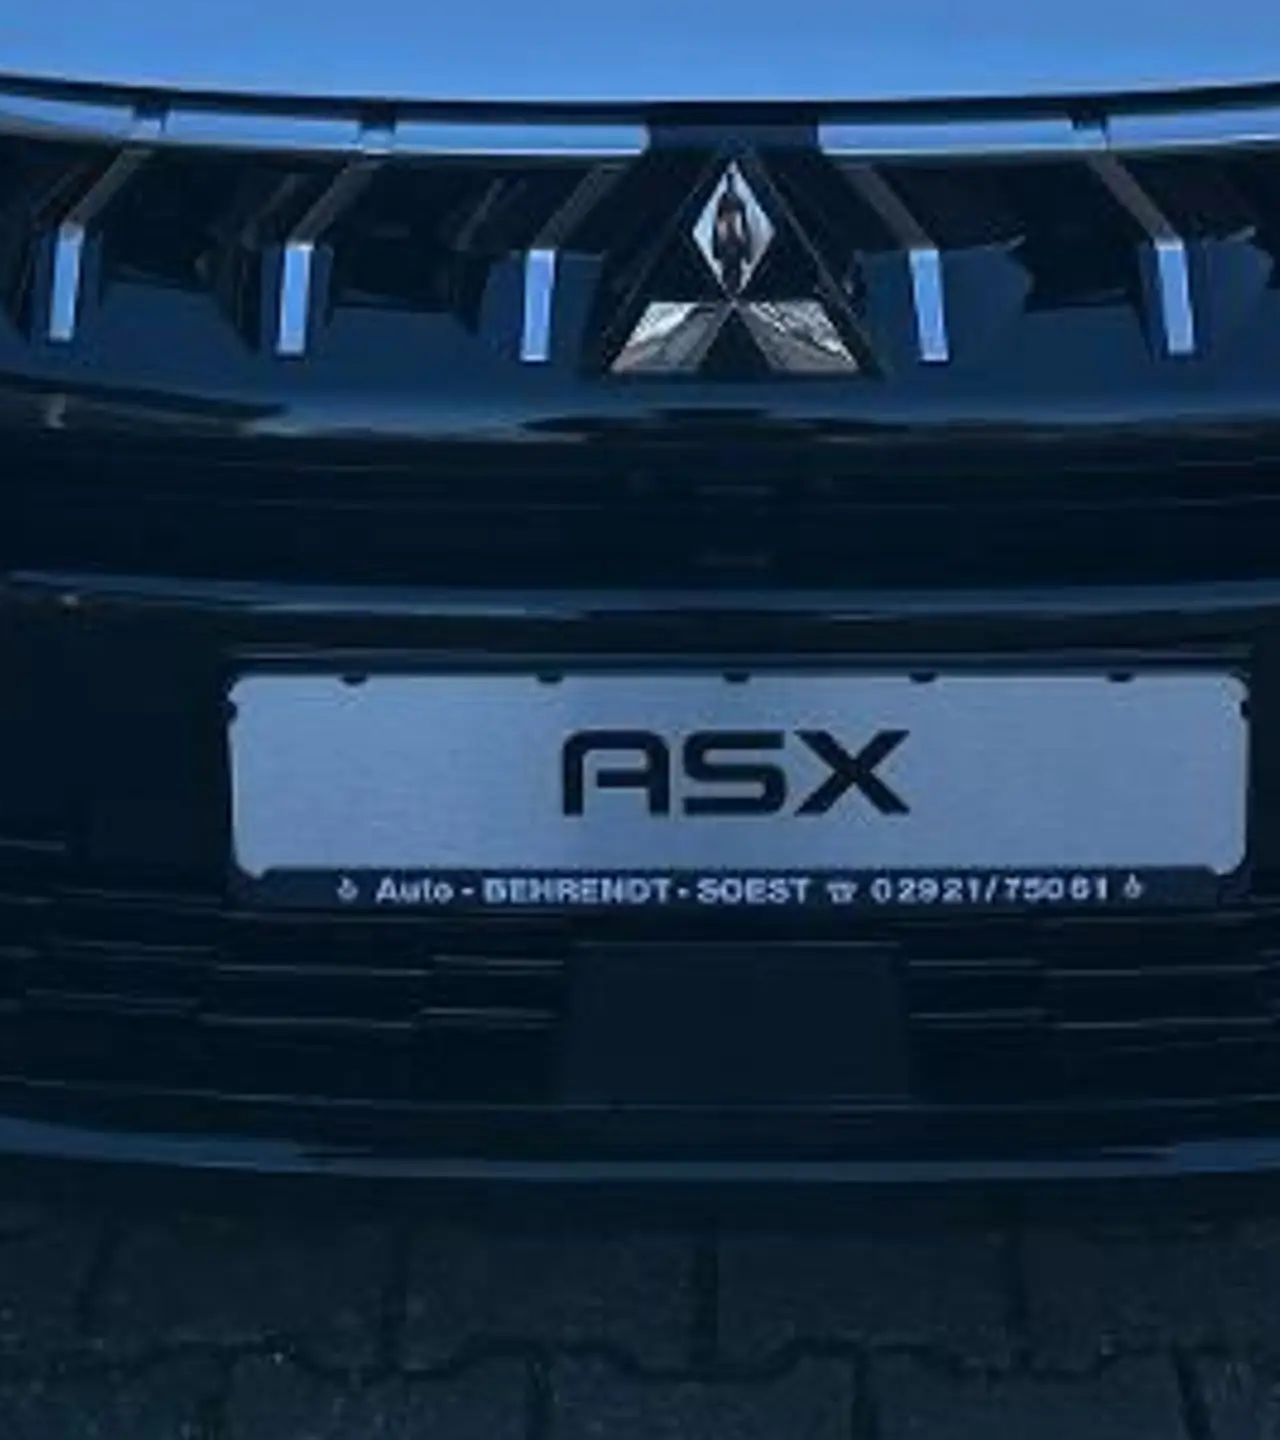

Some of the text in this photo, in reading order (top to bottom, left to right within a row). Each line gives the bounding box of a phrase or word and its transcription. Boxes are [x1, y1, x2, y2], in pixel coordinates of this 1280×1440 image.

[560, 729, 911, 817] ASX
[375, 876, 455, 905] Auto
[483, 877, 671, 905] BEHRENDT
[696, 877, 812, 905] SOEST
